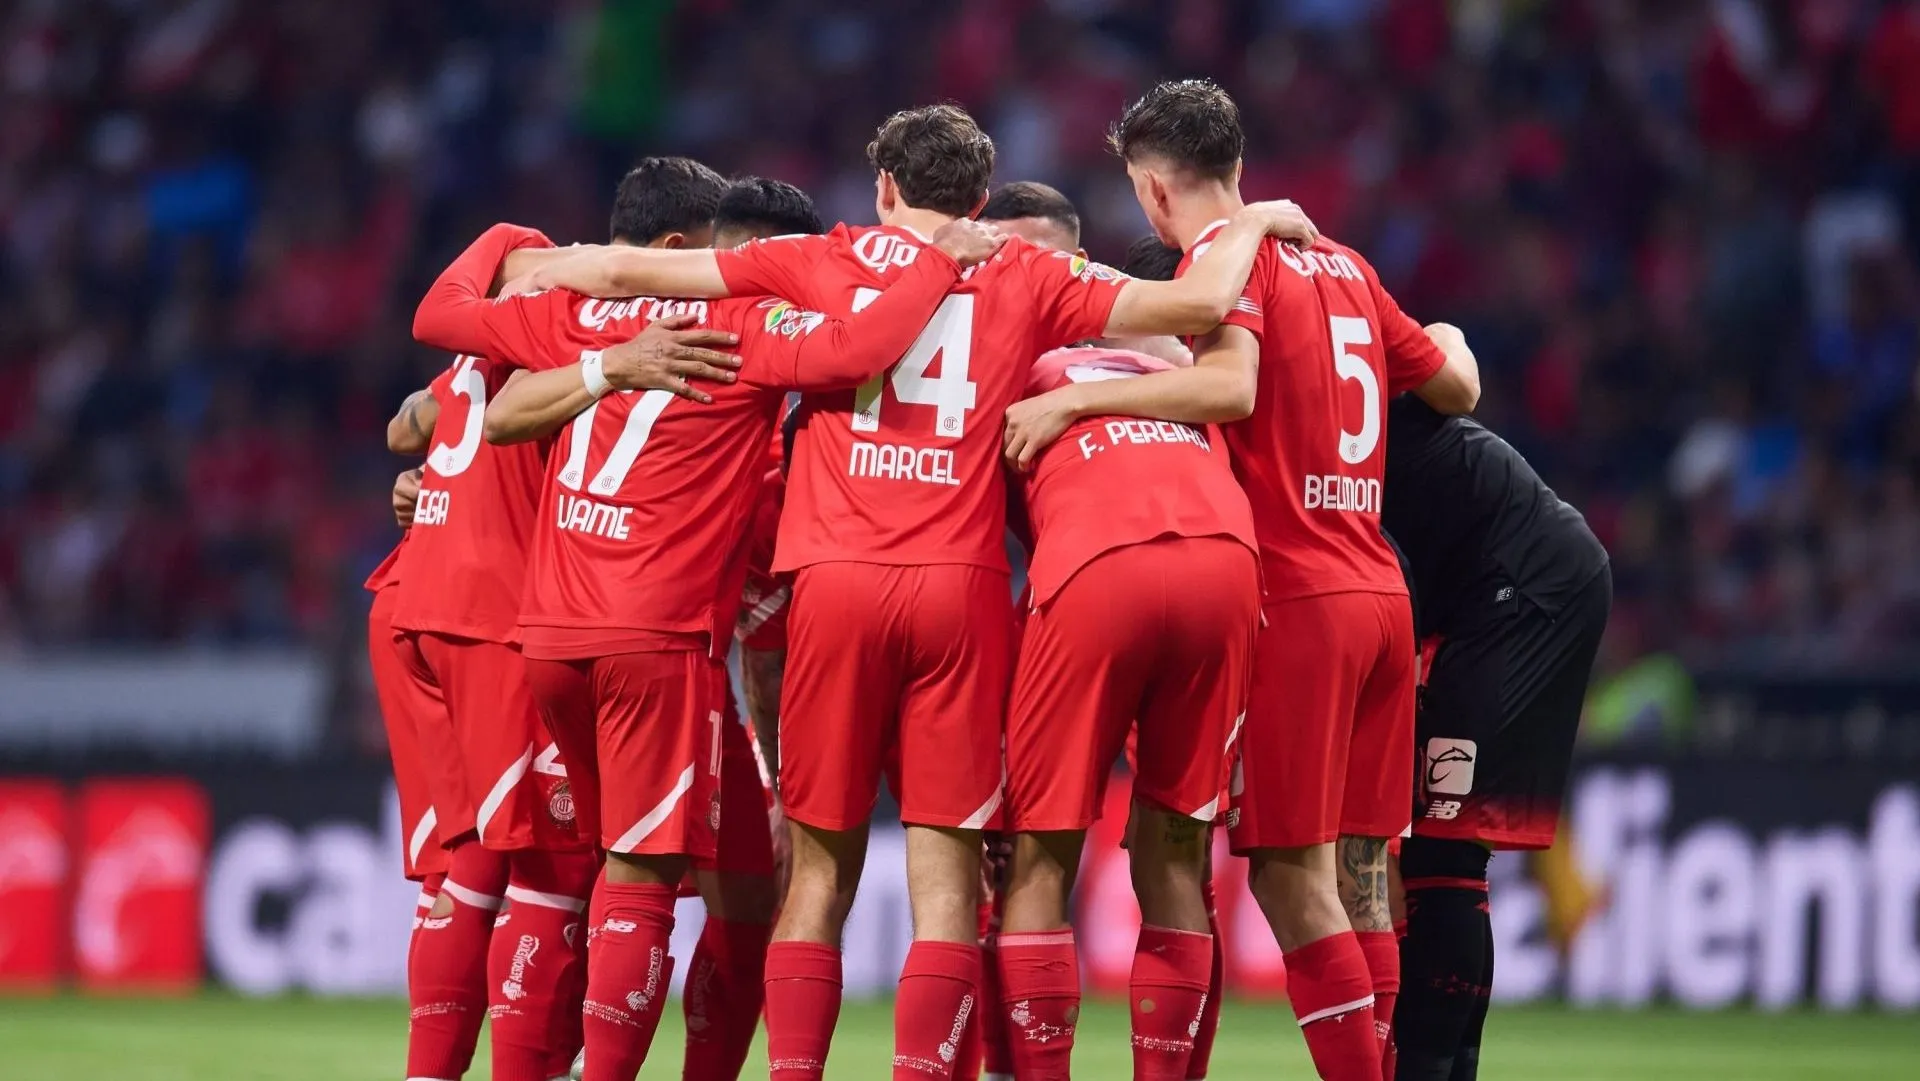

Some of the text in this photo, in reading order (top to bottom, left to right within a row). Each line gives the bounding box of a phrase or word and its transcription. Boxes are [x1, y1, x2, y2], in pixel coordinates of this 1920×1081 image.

[1329, 314, 1381, 465] 5
[1077, 420, 1211, 460] F. PEREIRA
[848, 441, 961, 486] MARCEL
